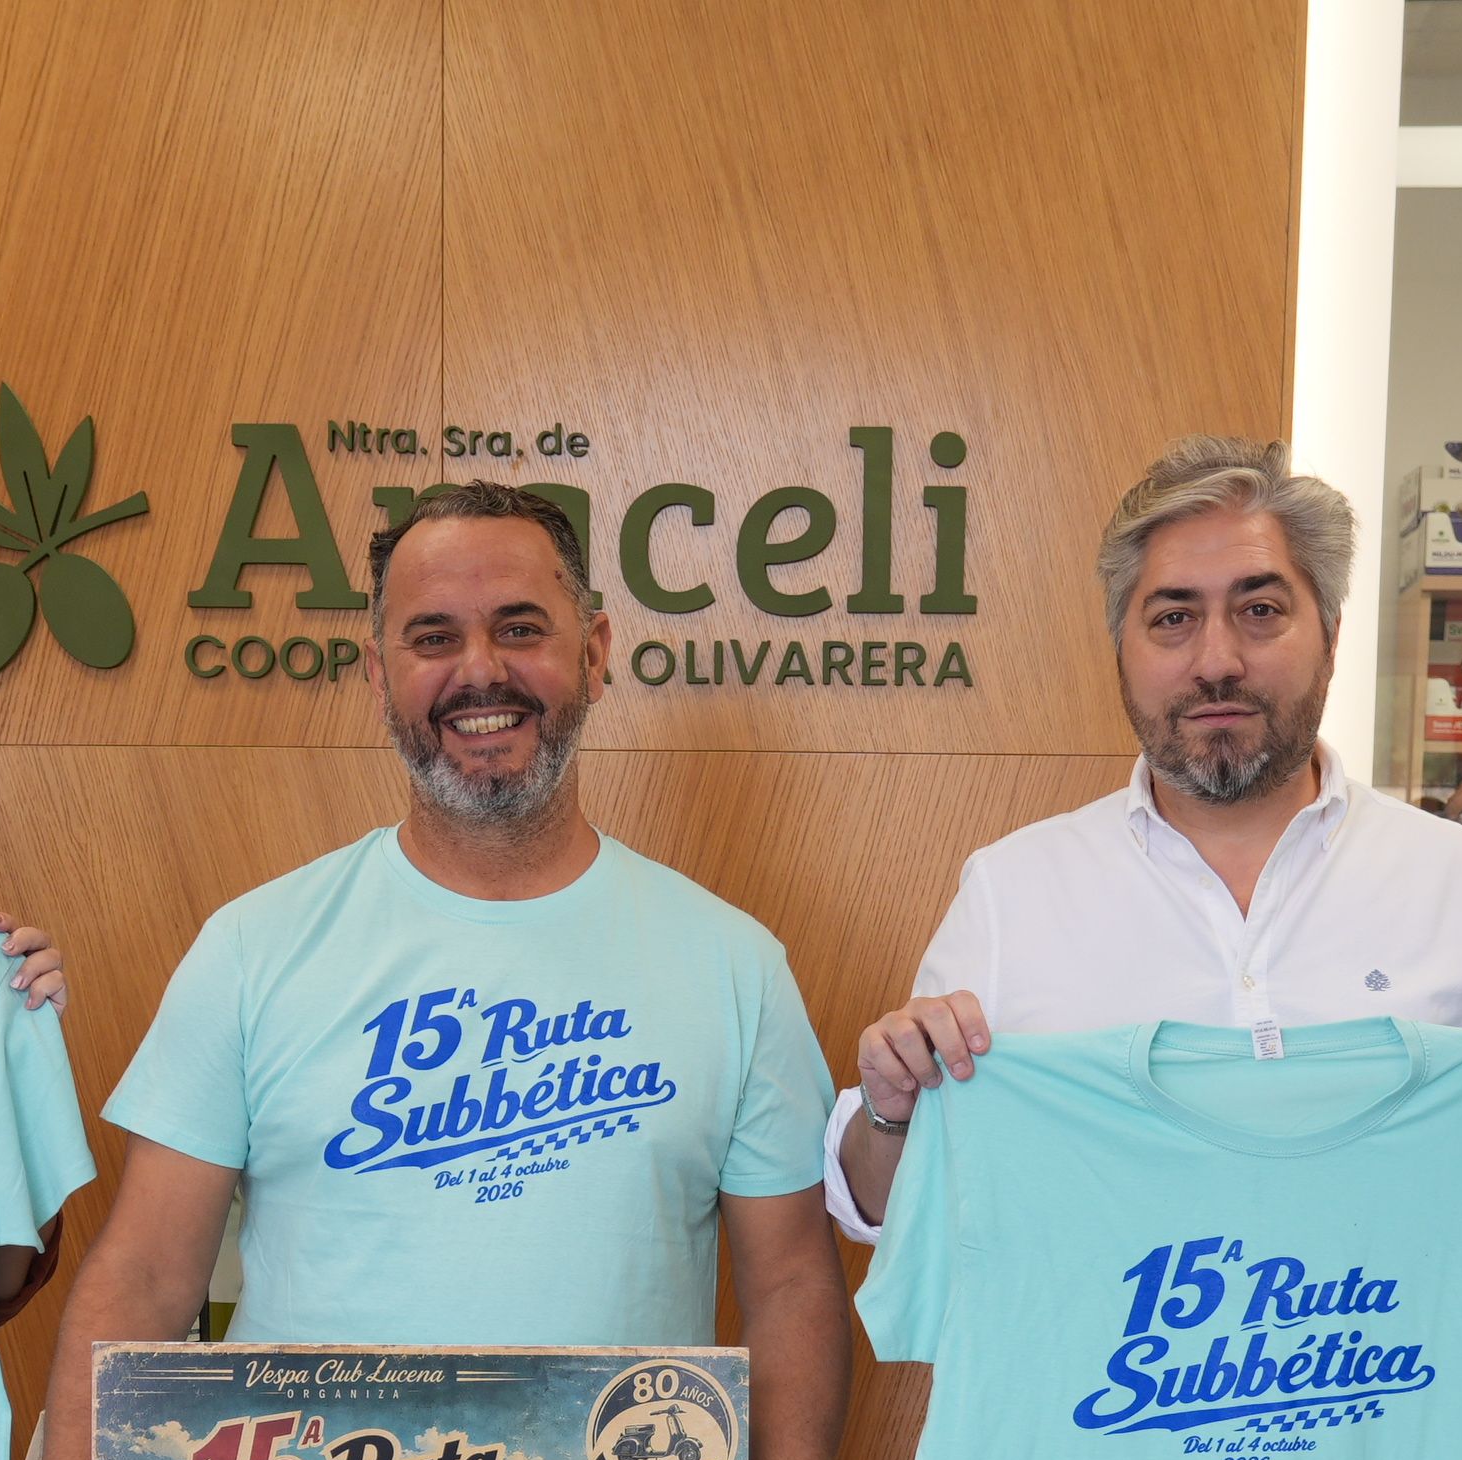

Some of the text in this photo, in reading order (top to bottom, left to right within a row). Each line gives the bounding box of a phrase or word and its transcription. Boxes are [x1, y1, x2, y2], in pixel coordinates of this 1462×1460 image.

[327, 420, 590, 458] Ntra. Sra. de
[187, 423, 977, 617] Aceli
[631, 639, 973, 687] OLIVARERA
[480, 998, 632, 1064] Ruta
[324, 1053, 677, 1170] Subbética
[434, 1157, 570, 1189] Del 1 al 4 octubre
[475, 1181, 524, 1204] 2026
[1241, 1256, 1400, 1326] Ruta
[246, 1356, 445, 1391] Vespa Club Lucena
[287, 1388, 400, 1399] ORGANIZA
[633, 1368, 715, 1408] 80 AÑOS
[1073, 1330, 1436, 1430] Subbética
[1183, 1435, 1316, 1454] Del 1 al 4 octubre
